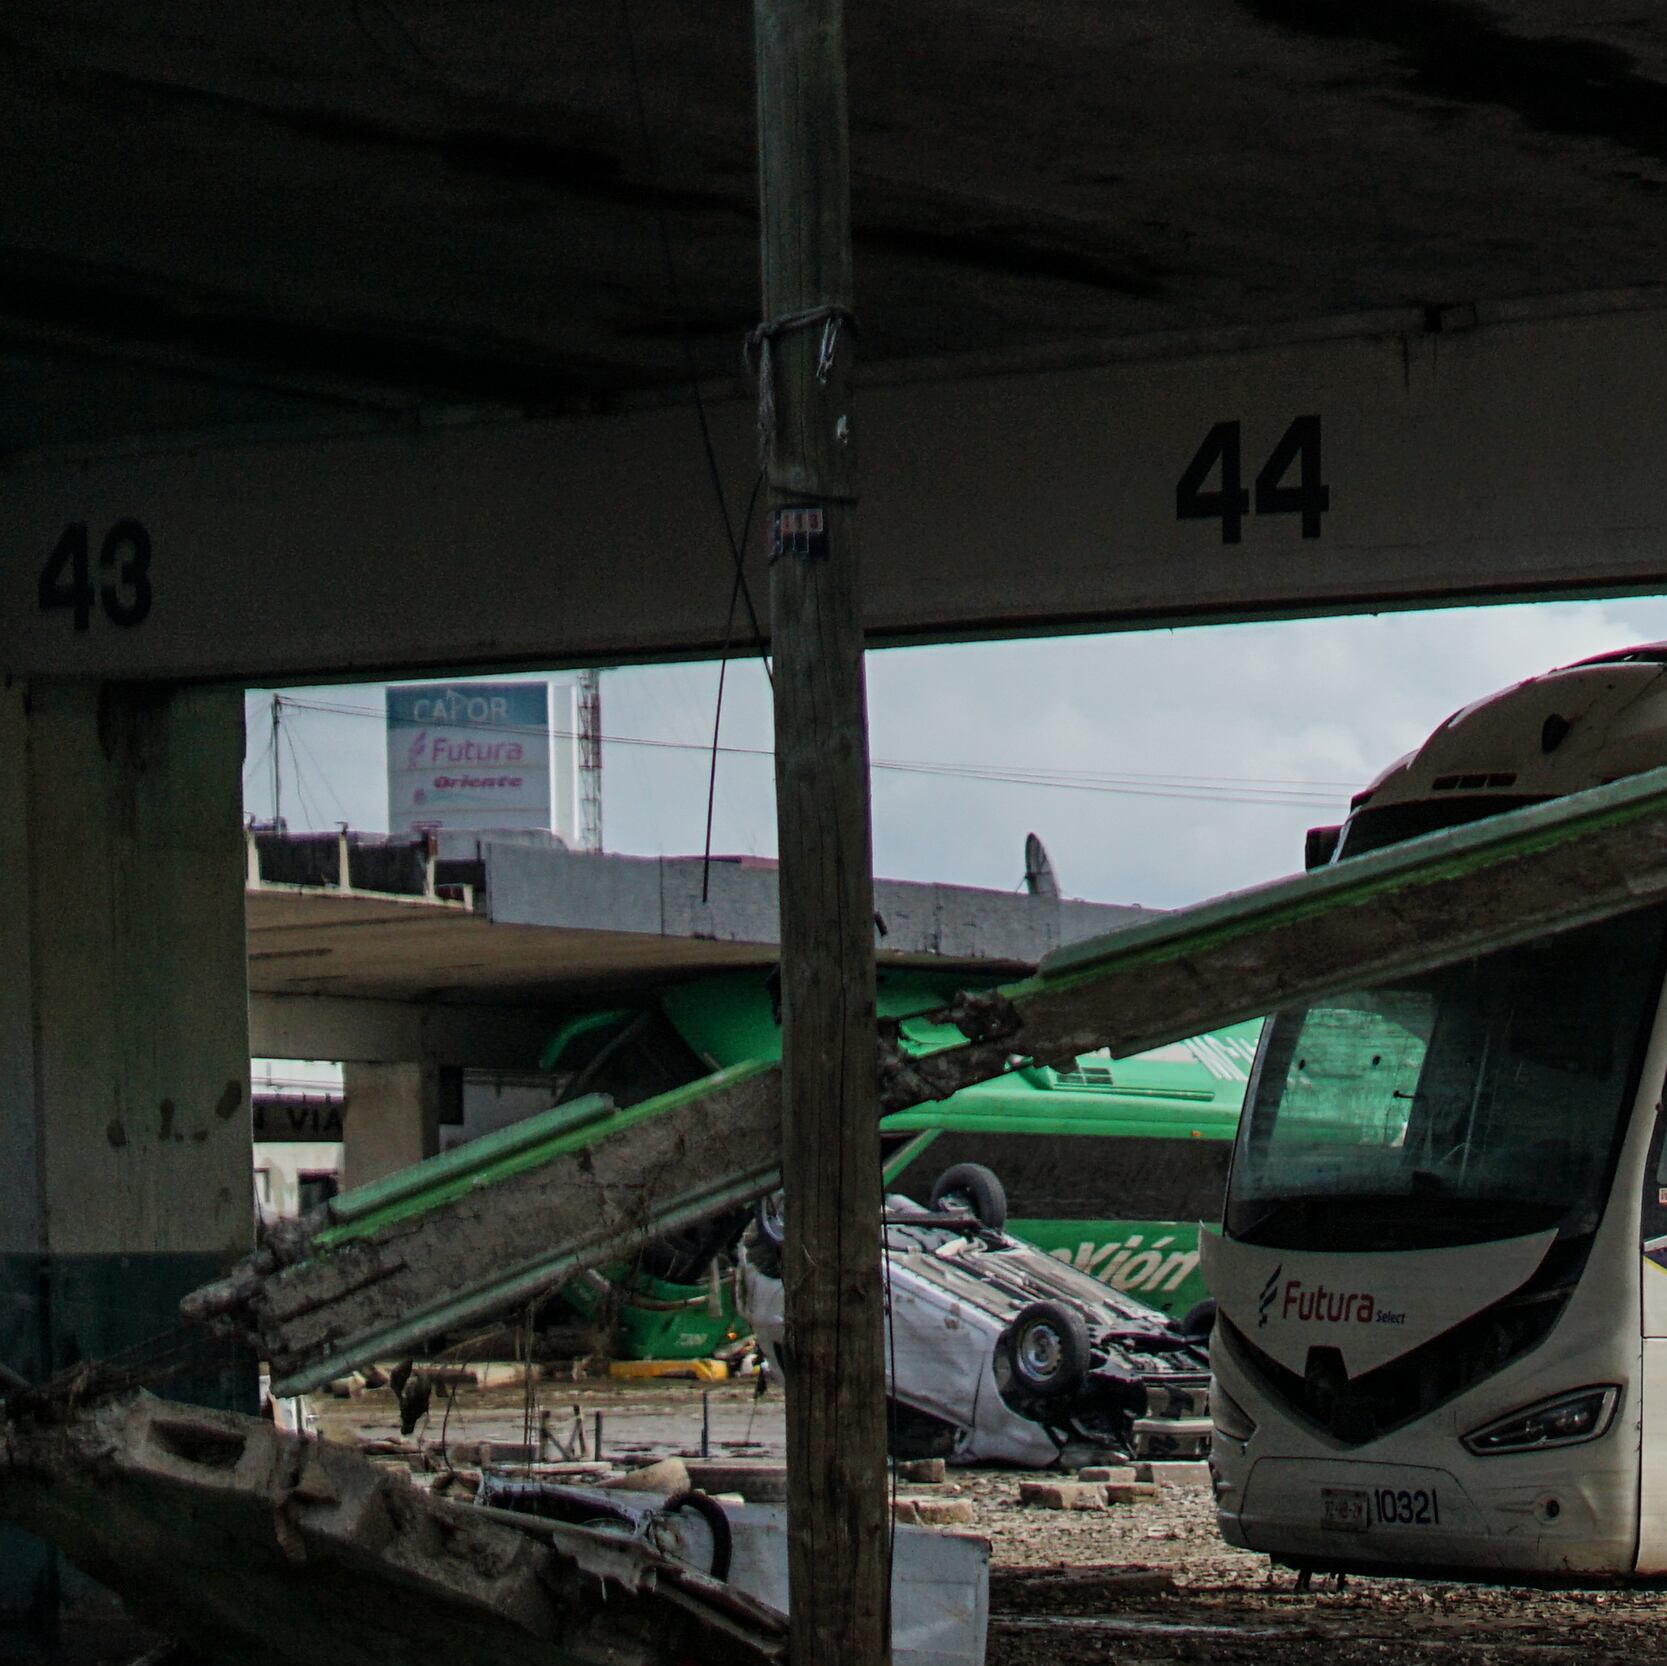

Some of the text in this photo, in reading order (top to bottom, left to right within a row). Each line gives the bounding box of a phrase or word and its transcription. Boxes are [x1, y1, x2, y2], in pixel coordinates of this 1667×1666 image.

[1176, 414, 1329, 543] 44
[38, 518, 151, 632] 43
[431, 737, 523, 762] Futura
[1283, 1281, 1405, 1324] Futura Select
[1374, 1488, 1439, 1524] 10321
